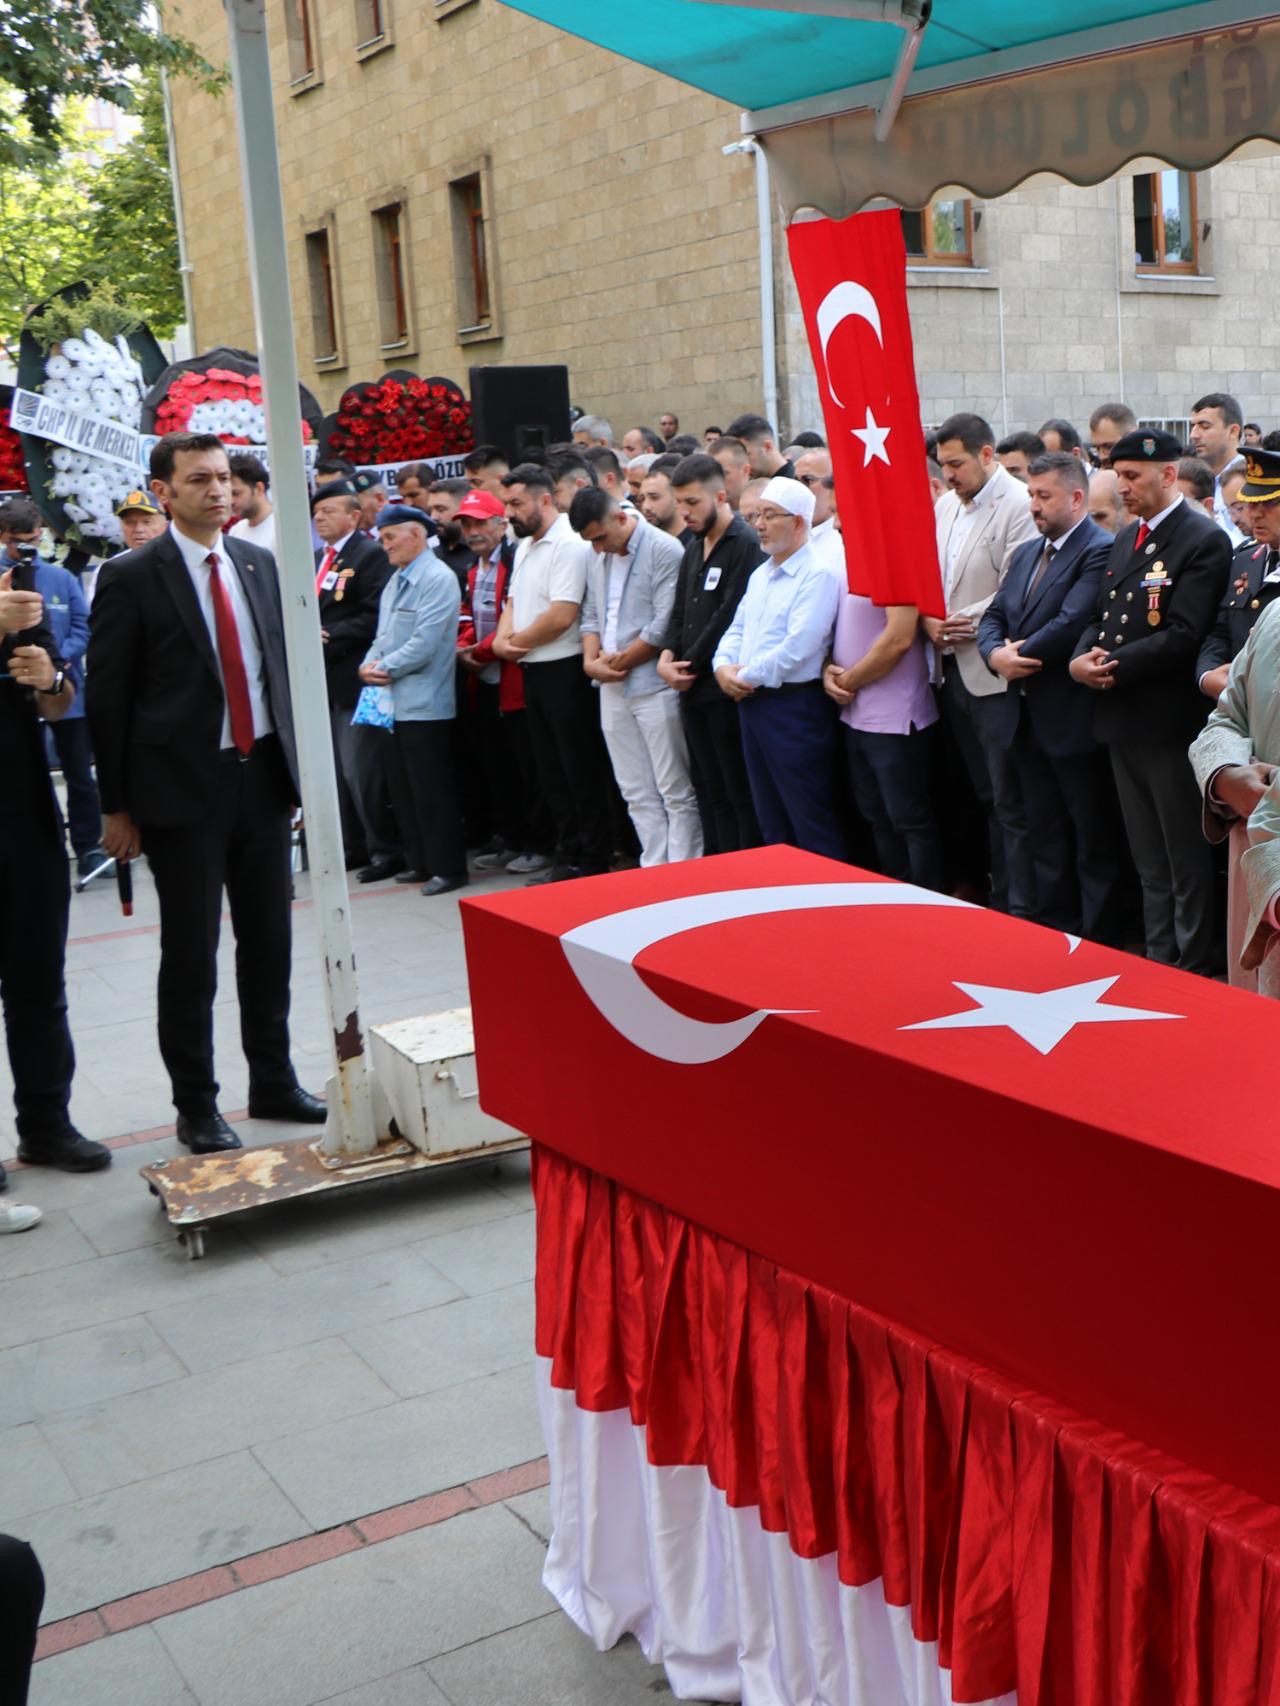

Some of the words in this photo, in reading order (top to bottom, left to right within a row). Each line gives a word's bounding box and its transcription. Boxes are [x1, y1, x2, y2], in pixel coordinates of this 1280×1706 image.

[37, 403, 65, 435] CHP
[77, 417, 97, 447] VE
[93, 423, 137, 462] MERKEZ
